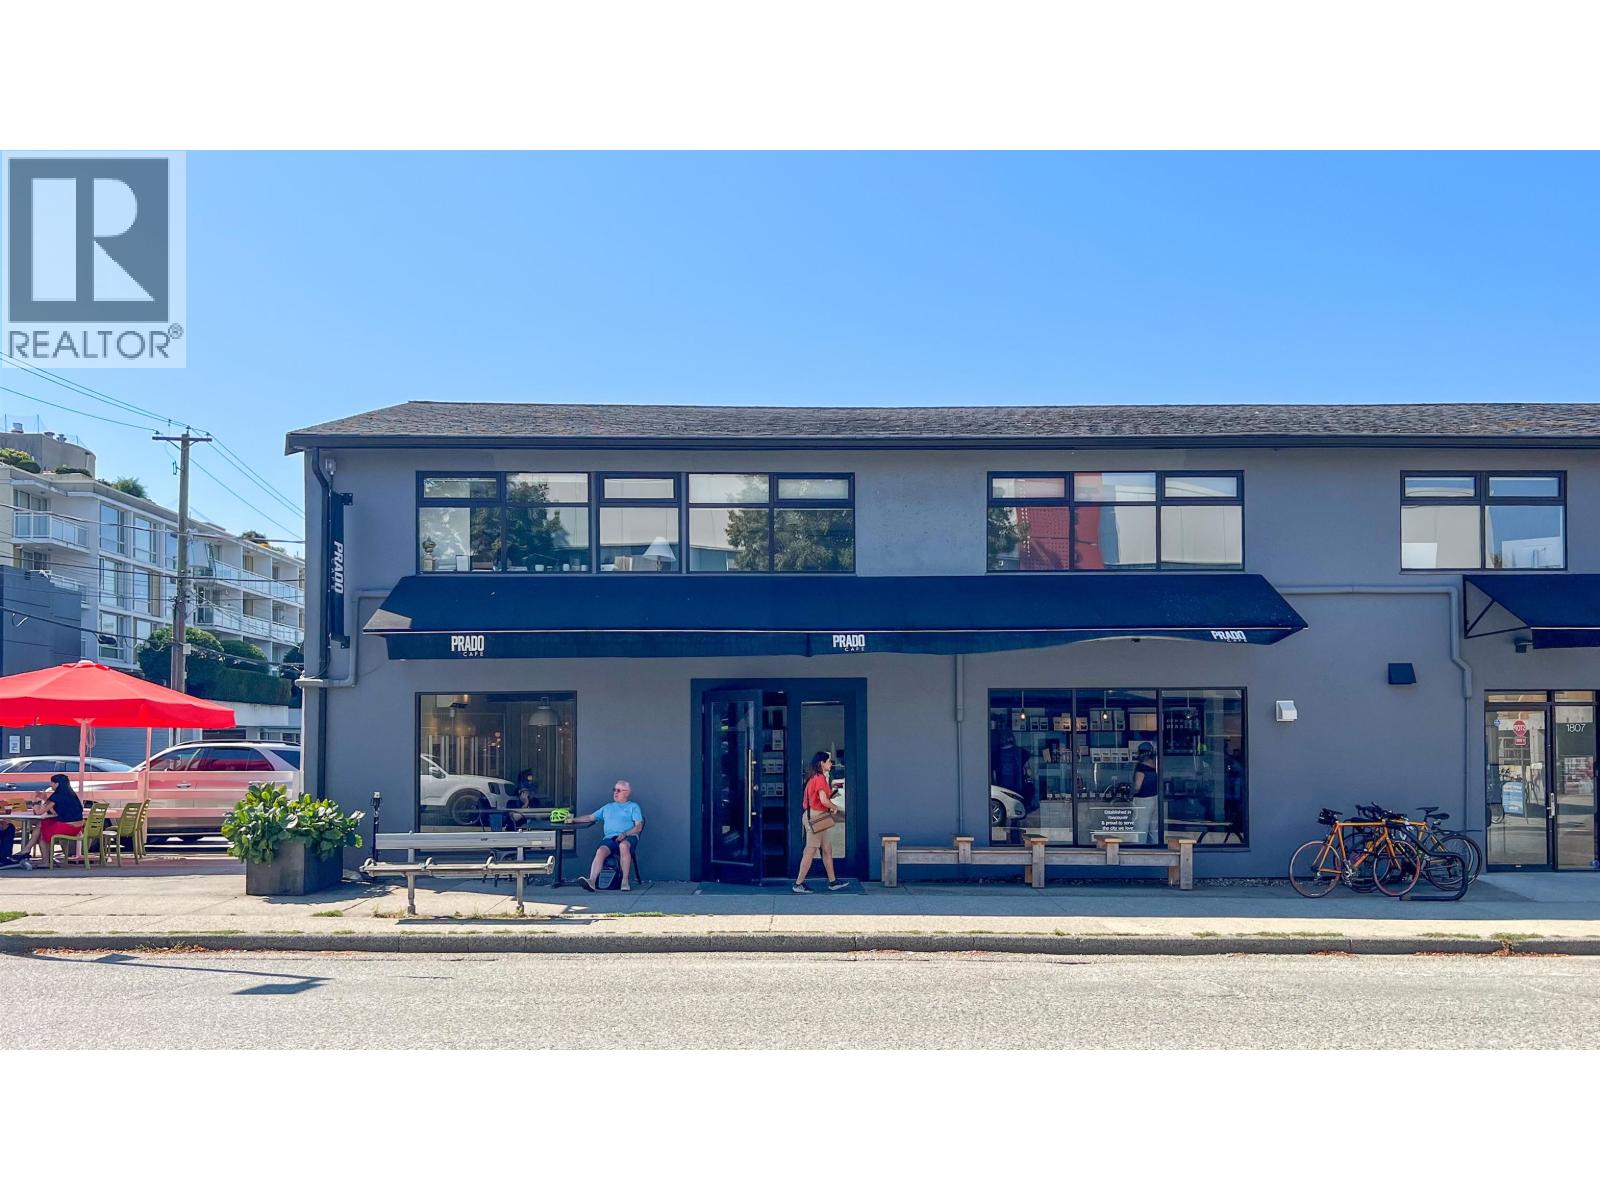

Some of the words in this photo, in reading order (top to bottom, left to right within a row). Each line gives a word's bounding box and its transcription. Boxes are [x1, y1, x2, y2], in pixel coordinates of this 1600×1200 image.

[333, 540, 344, 594] PRADO
[832, 634, 865, 648] PRADO
[1210, 630, 1247, 640] PRADO
[451, 635, 485, 652] PRADO
[1566, 723, 1586, 733] 1807
